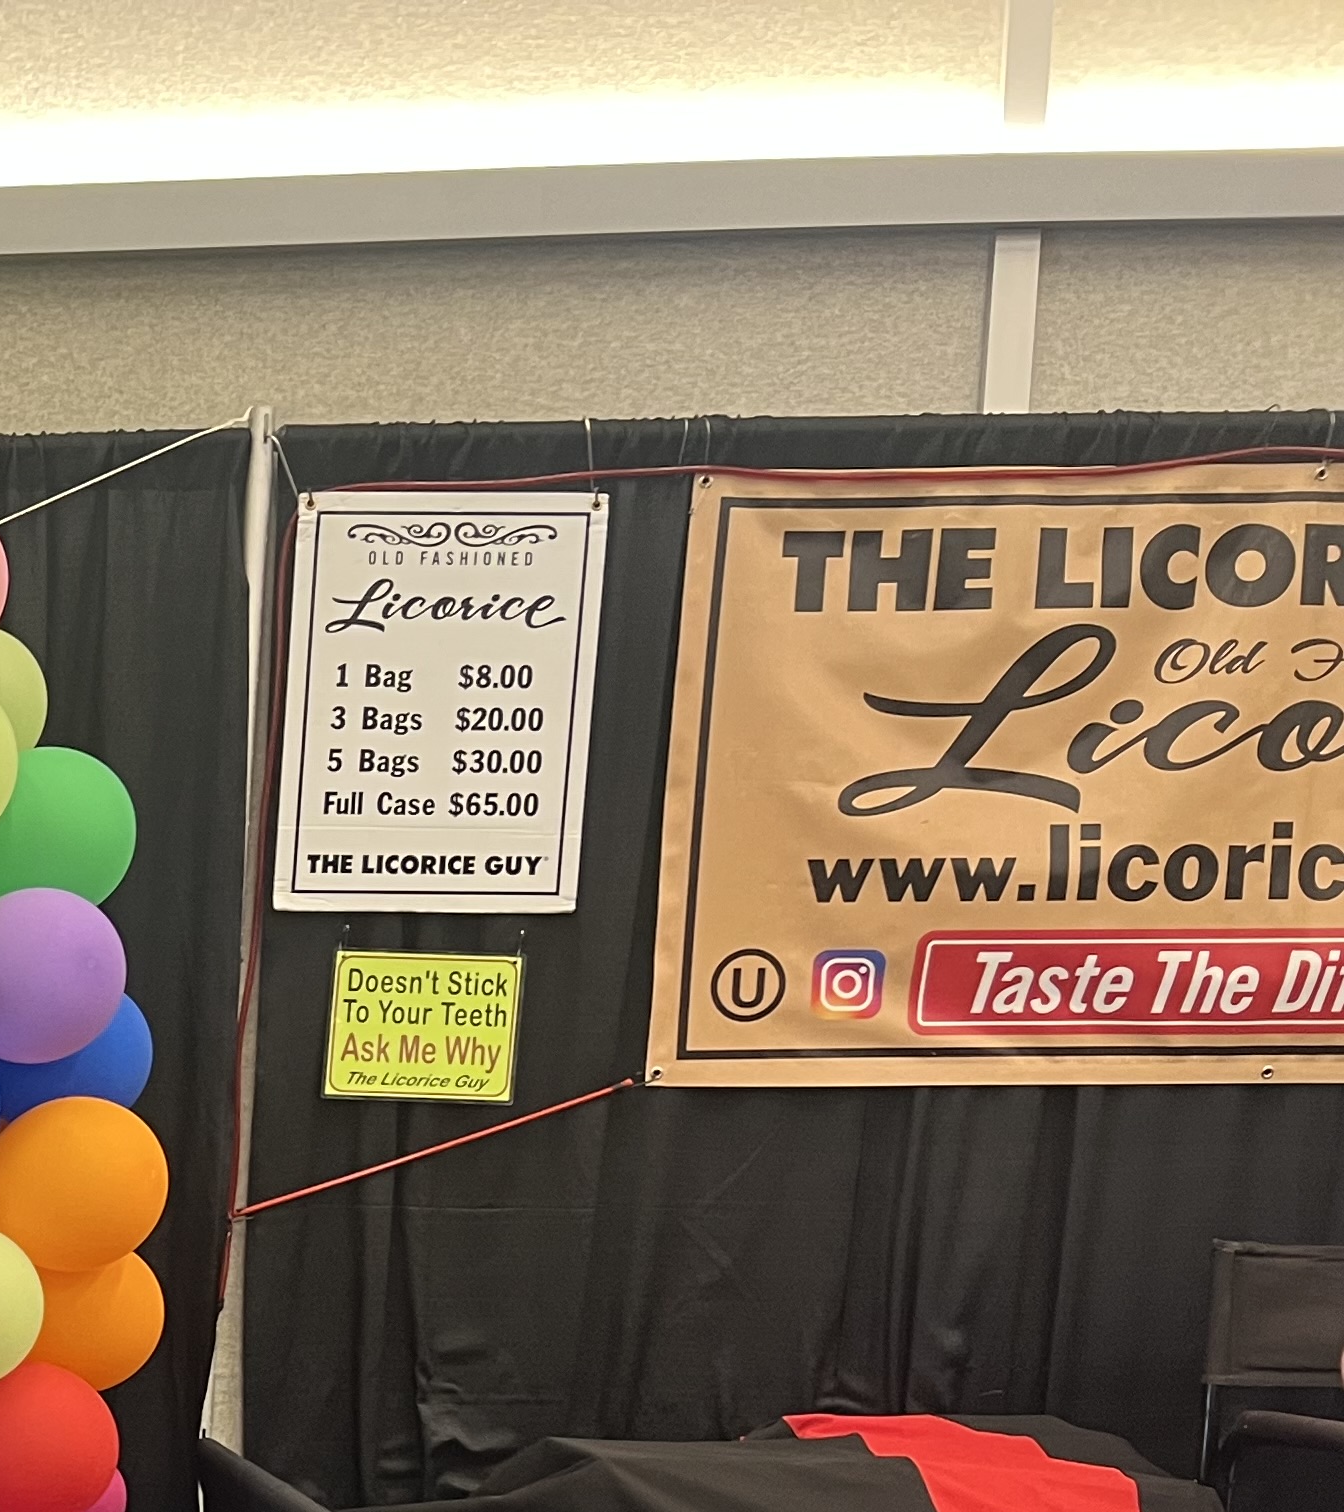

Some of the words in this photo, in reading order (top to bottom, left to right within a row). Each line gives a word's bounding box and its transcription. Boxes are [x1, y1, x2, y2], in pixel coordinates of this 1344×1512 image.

[367, 550, 405, 566] OLD
[419, 550, 534, 567] FASHIONED
[782, 526, 997, 613] THE
[324, 578, 568, 633] Licorice
[1153, 638, 1268, 684] Old
[335, 665, 349, 687] 1
[364, 665, 413, 693] Bag
[458, 663, 533, 690] $8.00
[330, 708, 346, 731] 3
[361, 707, 423, 736] Bags
[454, 706, 544, 733] $20.00
[326, 750, 343, 773] 5
[358, 750, 420, 778] Bags
[451, 749, 543, 776] $30.00
[322, 791, 363, 816] Full
[376, 792, 435, 817] Case
[447, 791, 539, 818] $65.00
[307, 853, 353, 875] THE
[360, 853, 476, 876] LICORICE
[483, 854, 543, 877] GUY
[347, 967, 440, 995] Doesn't
[447, 970, 508, 997] Stick
[968, 951, 1136, 1014] Taste
[1149, 950, 1256, 1014] The
[343, 999, 372, 1024] To
[378, 999, 433, 1027] Your
[440, 1002, 508, 1028] Teeth
[340, 1032, 390, 1064] Ask
[397, 1034, 438, 1065] Me
[444, 1035, 501, 1074] Why
[346, 1070, 378, 1087] The
[383, 1071, 446, 1089] Licorice
[451, 1073, 489, 1093] Guy
